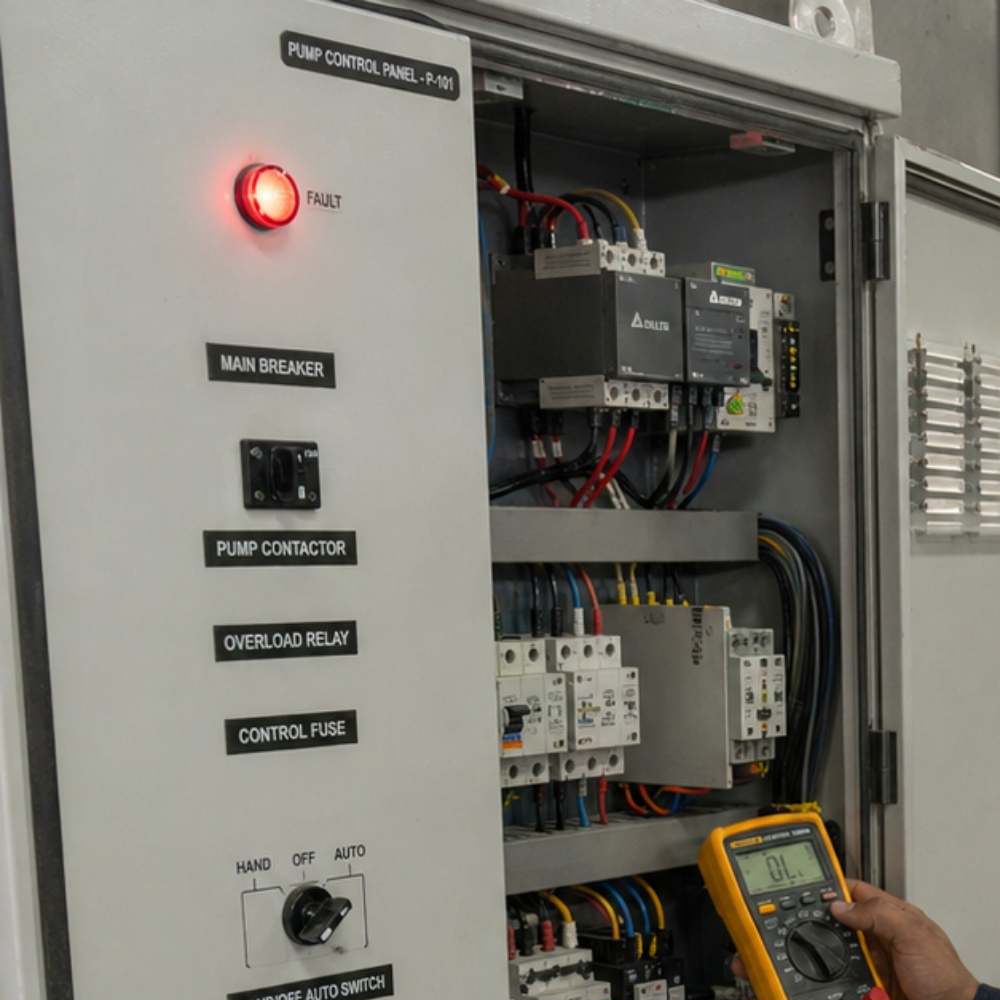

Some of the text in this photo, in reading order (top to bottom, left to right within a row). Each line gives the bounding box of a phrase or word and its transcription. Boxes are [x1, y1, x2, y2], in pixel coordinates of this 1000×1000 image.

[288, 41, 322, 63] PUMP
[325, 51, 380, 76] CONTROL
[382, 61, 418, 84] PANEL
[307, 190, 342, 209] FAULT
[220, 353, 325, 378] MAIN BREAKER
[216, 539, 346, 557] PUMP CONTACTOR
[223, 630, 349, 652] OVERLOAD RELAY
[238, 720, 346, 744] CONTROL FUSE
[292, 851, 315, 867] OFF
[334, 844, 366, 861] AUTO
[236, 857, 271, 875] HAND
[340, 974, 386, 997] SWITCH
